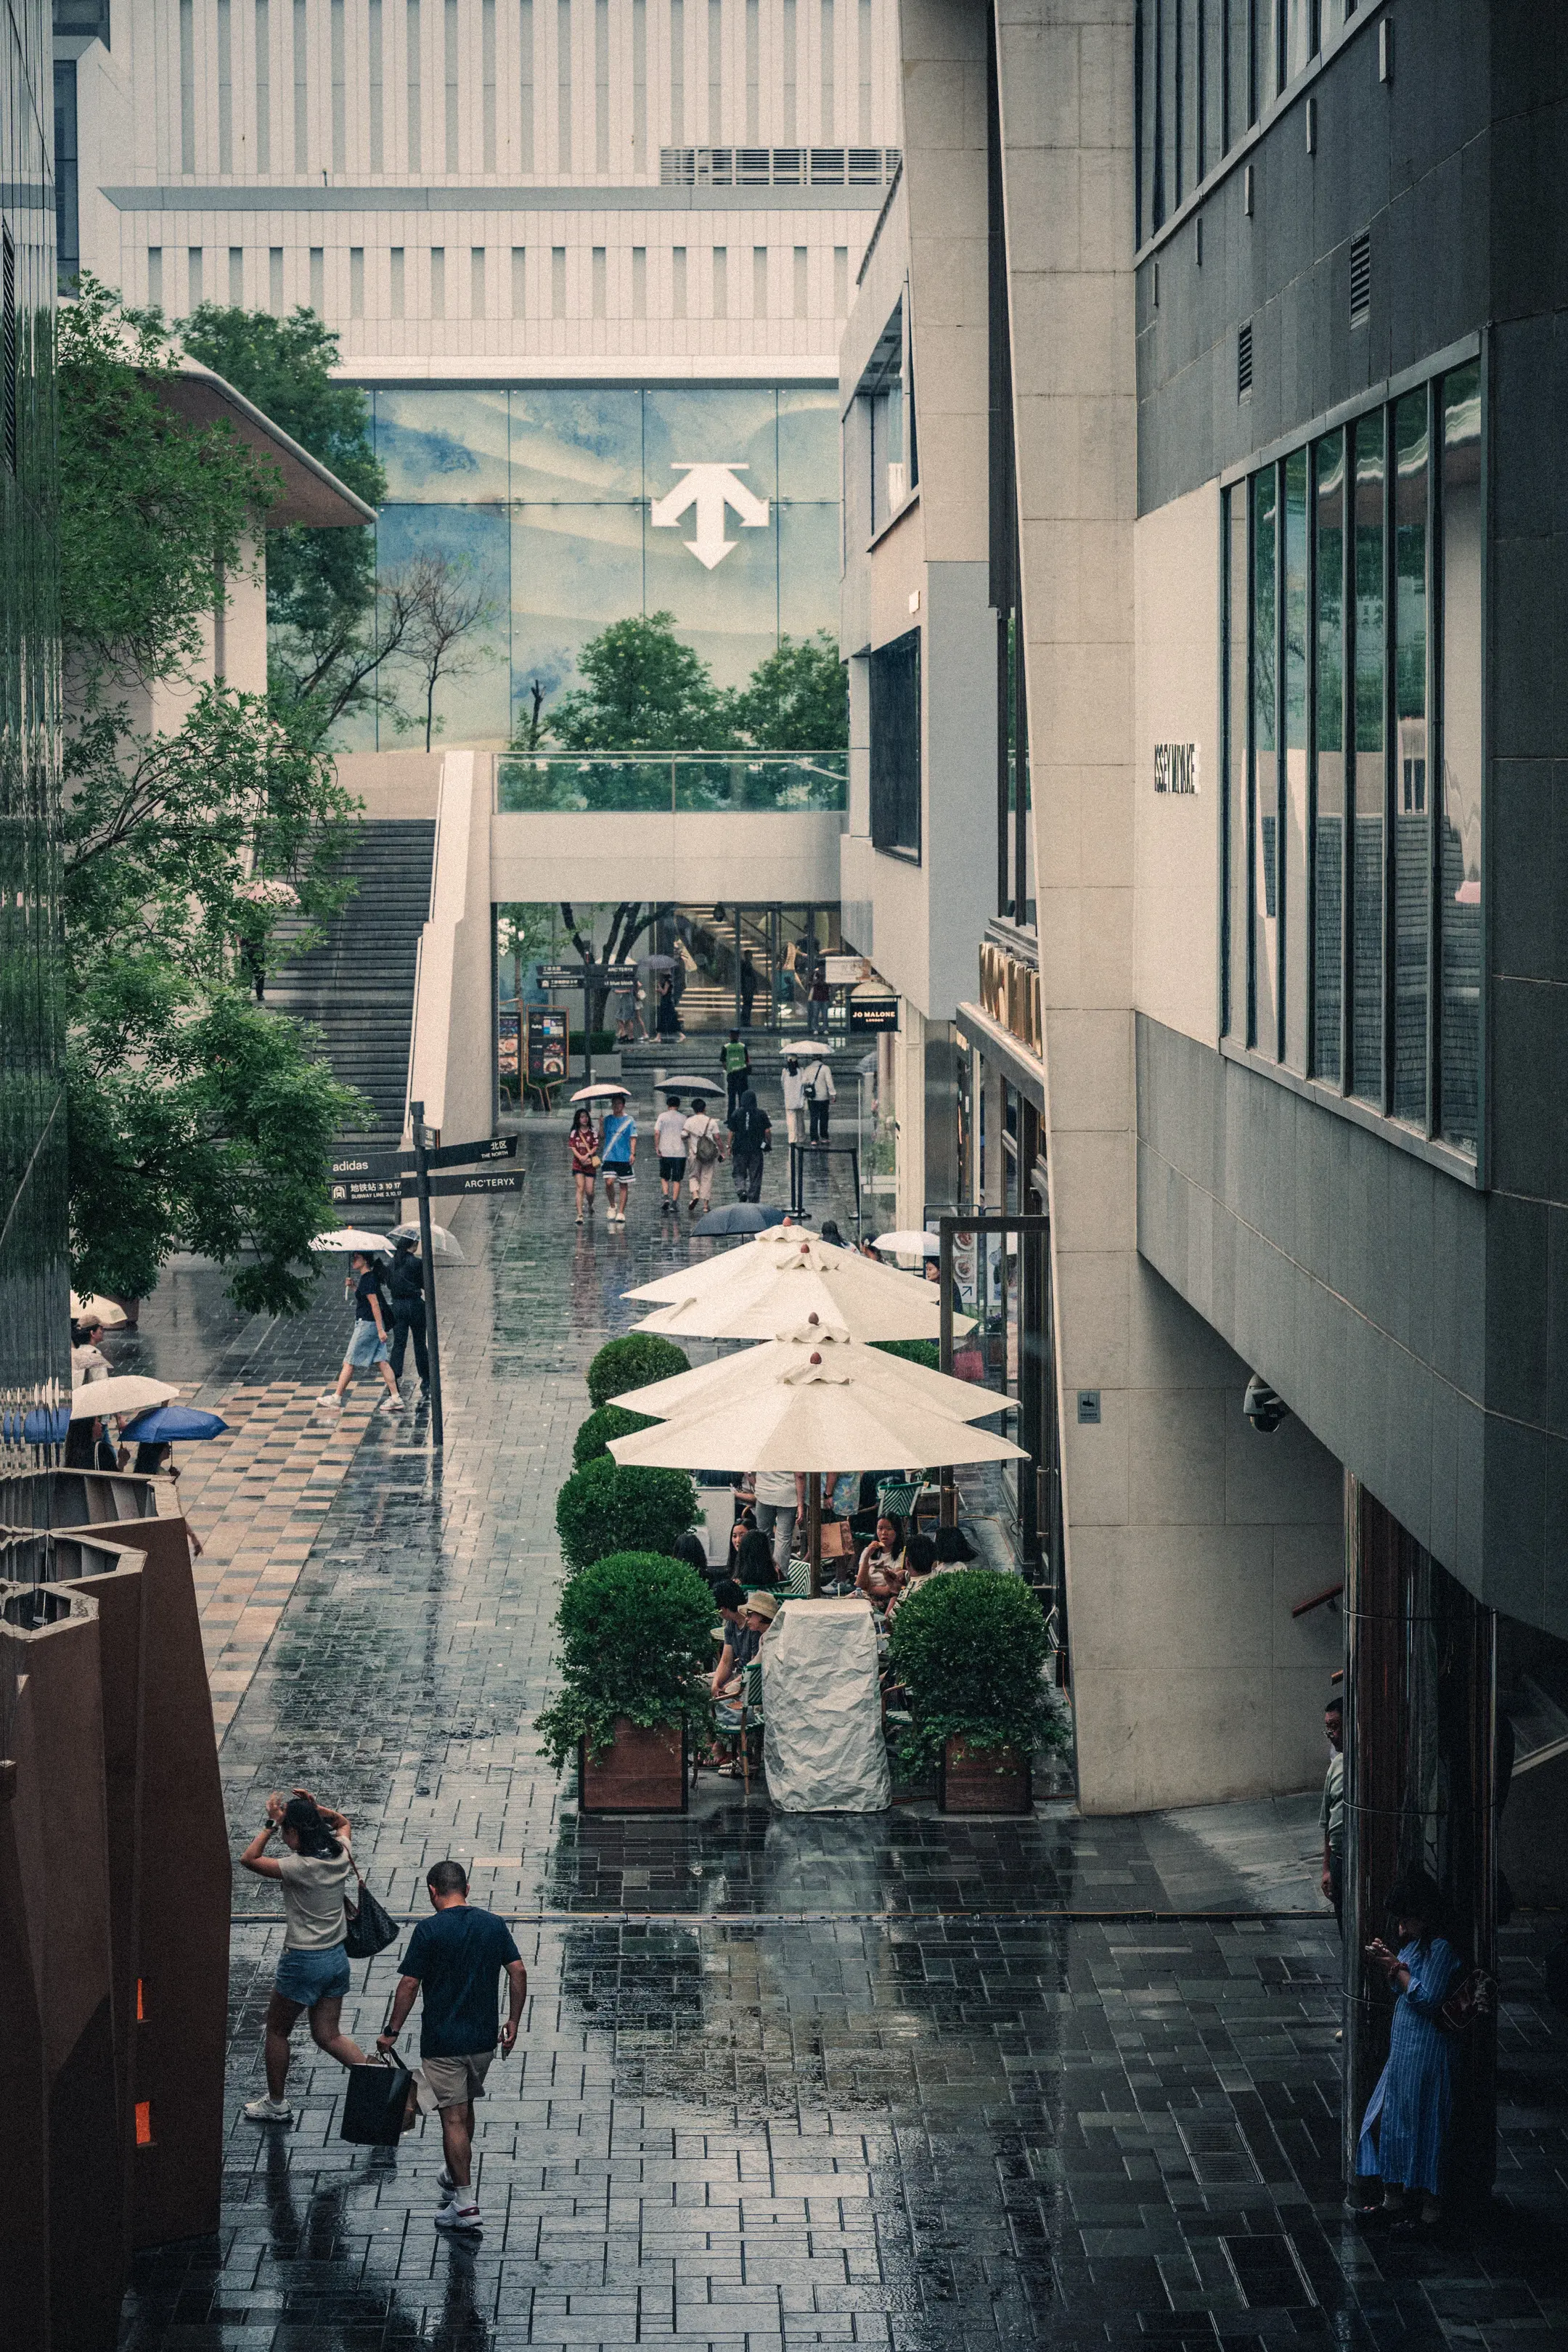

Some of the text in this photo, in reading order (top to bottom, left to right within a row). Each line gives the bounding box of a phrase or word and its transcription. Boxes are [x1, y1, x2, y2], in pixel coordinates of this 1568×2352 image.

[490, 1140, 508, 1151] 北区
[332, 1161, 369, 1172] adidas
[351, 1182, 377, 1193] 地铁站
[465, 1177, 515, 1188] ARC'TERYX
